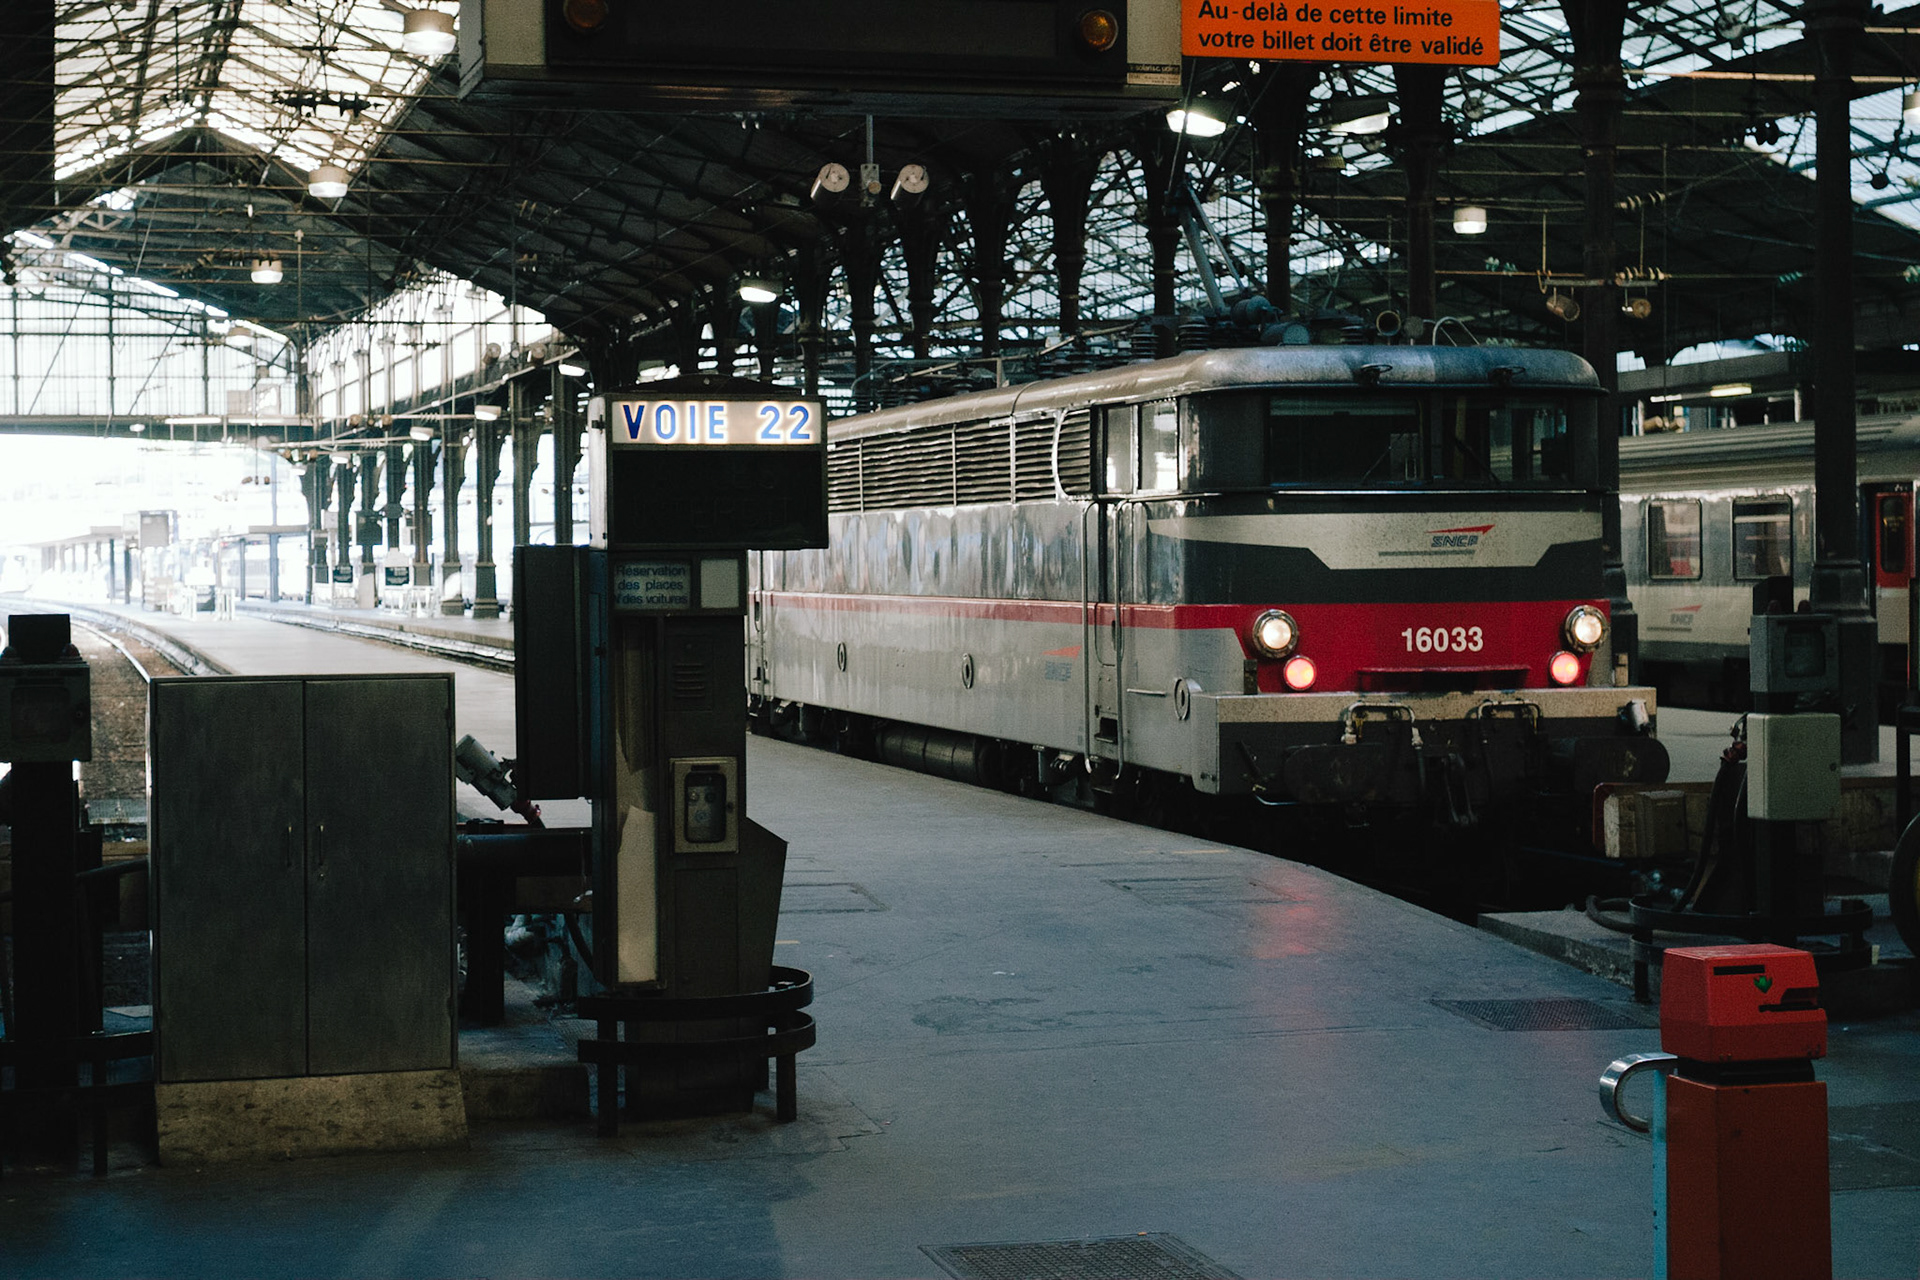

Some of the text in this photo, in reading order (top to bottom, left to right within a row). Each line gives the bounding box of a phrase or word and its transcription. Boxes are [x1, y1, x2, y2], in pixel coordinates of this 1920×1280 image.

[1296, 2, 1320, 22] de
[1329, 5, 1386, 24] cette
[1393, 6, 1453, 27] limite
[1199, 31, 1484, 56] votre billet doit être validé
[622, 404, 811, 440] VOIE 22
[1431, 535, 1479, 548] SNCF
[617, 579, 684, 592] des places
[622, 593, 643, 604] des
[645, 593, 687, 604] voitures
[1401, 626, 1484, 652] 16033
